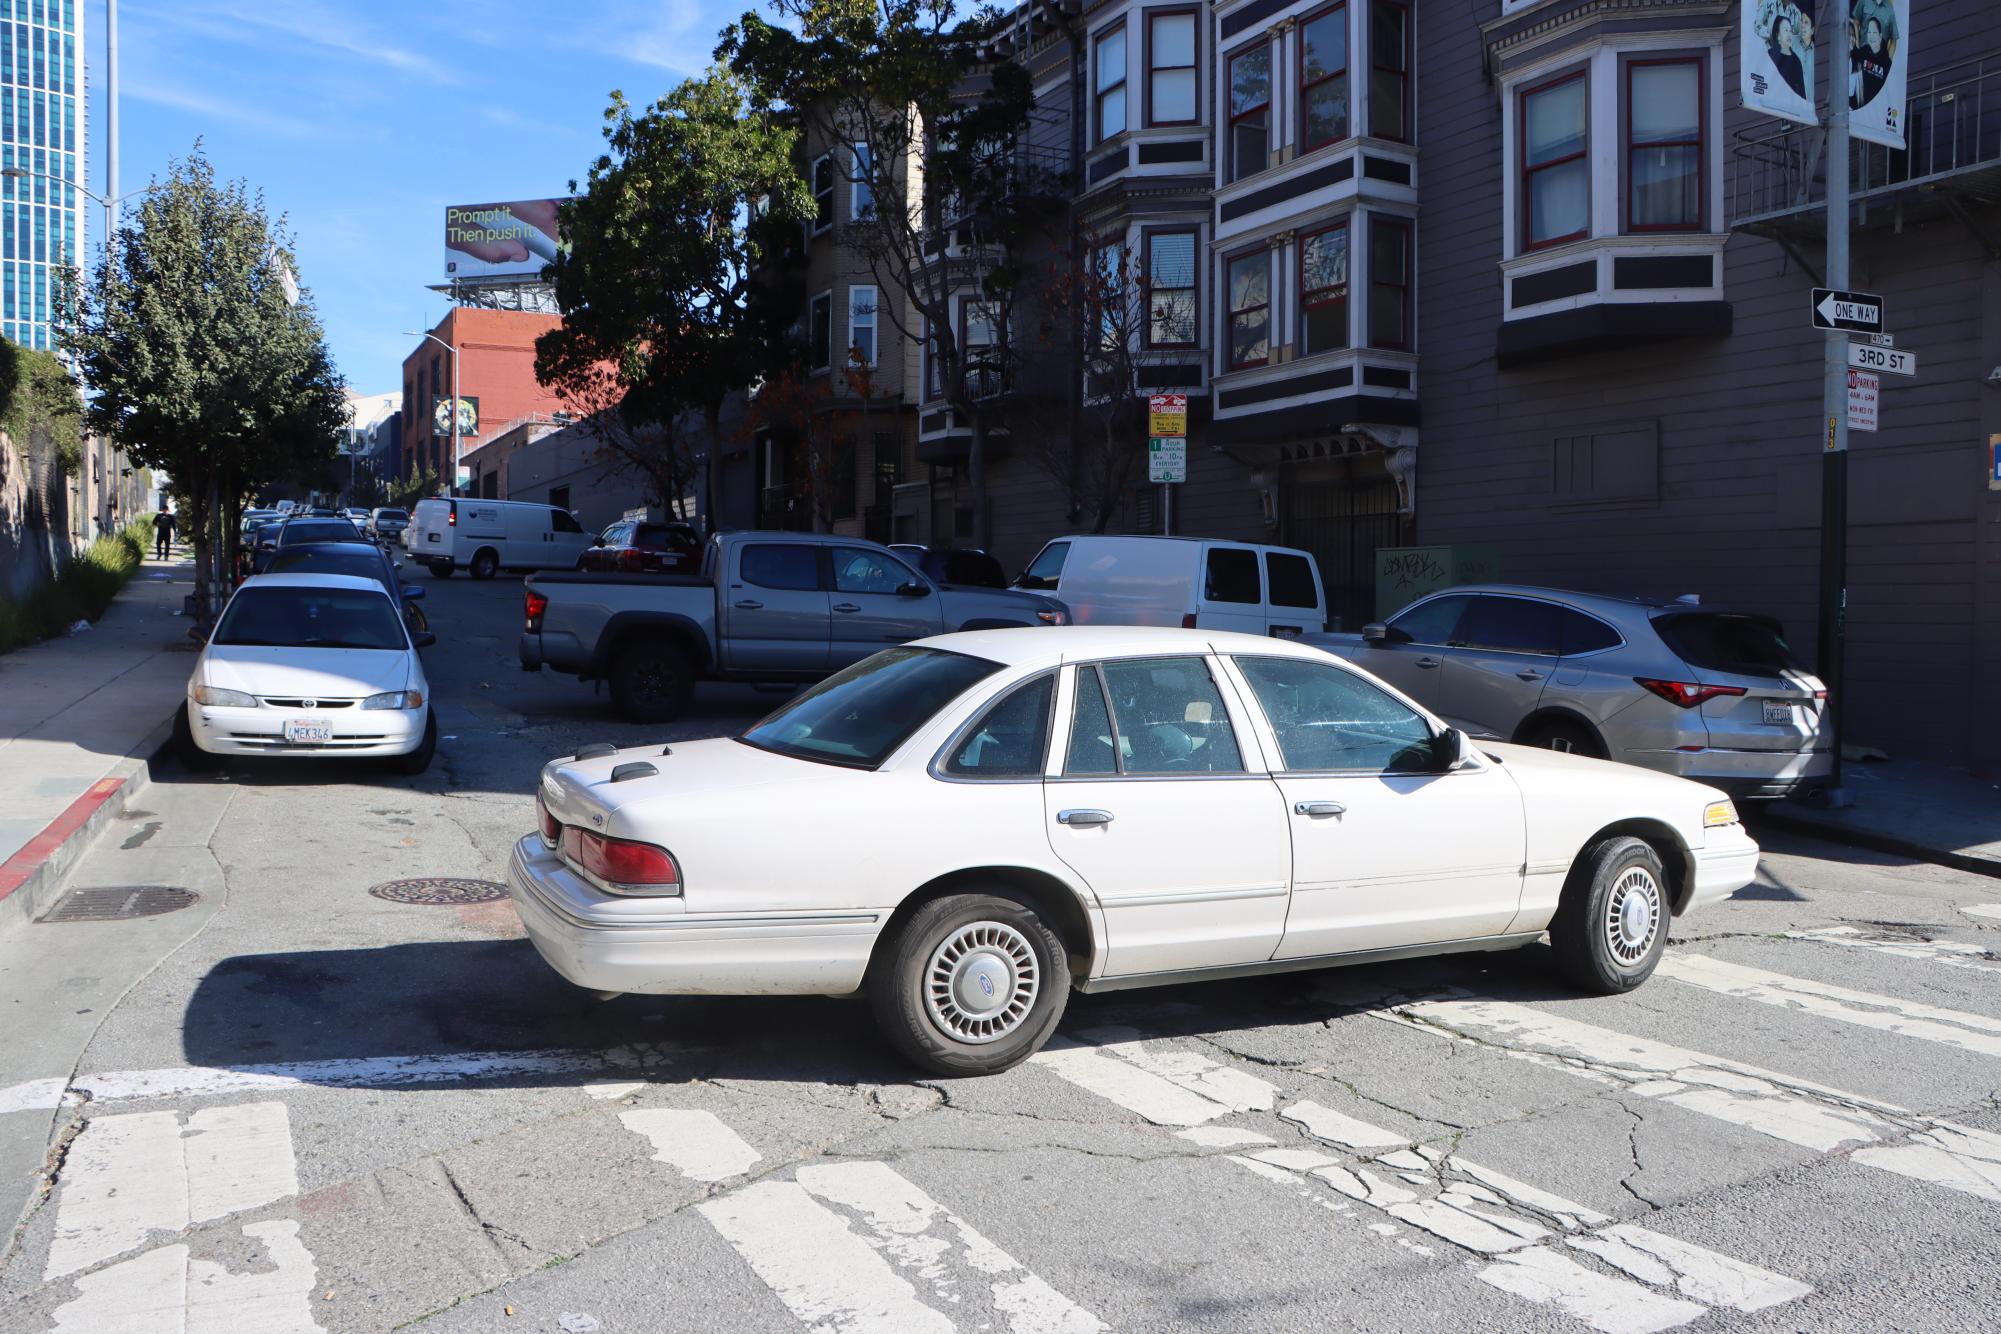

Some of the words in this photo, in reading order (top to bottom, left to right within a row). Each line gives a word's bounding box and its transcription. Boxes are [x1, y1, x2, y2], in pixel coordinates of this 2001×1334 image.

[447, 207, 500, 225] Prompt
[447, 227, 484, 243] Then
[486, 223, 521, 244] push
[1835, 303, 1854, 319] ONE
[1857, 306, 1876, 322] WAY
[1858, 349, 1885, 366] 3RD
[1889, 354, 1905, 370] ST
[1857, 376, 1878, 391] PARKING
[1151, 404, 1161, 413] NO
[288, 727, 329, 739] 4MEK346
